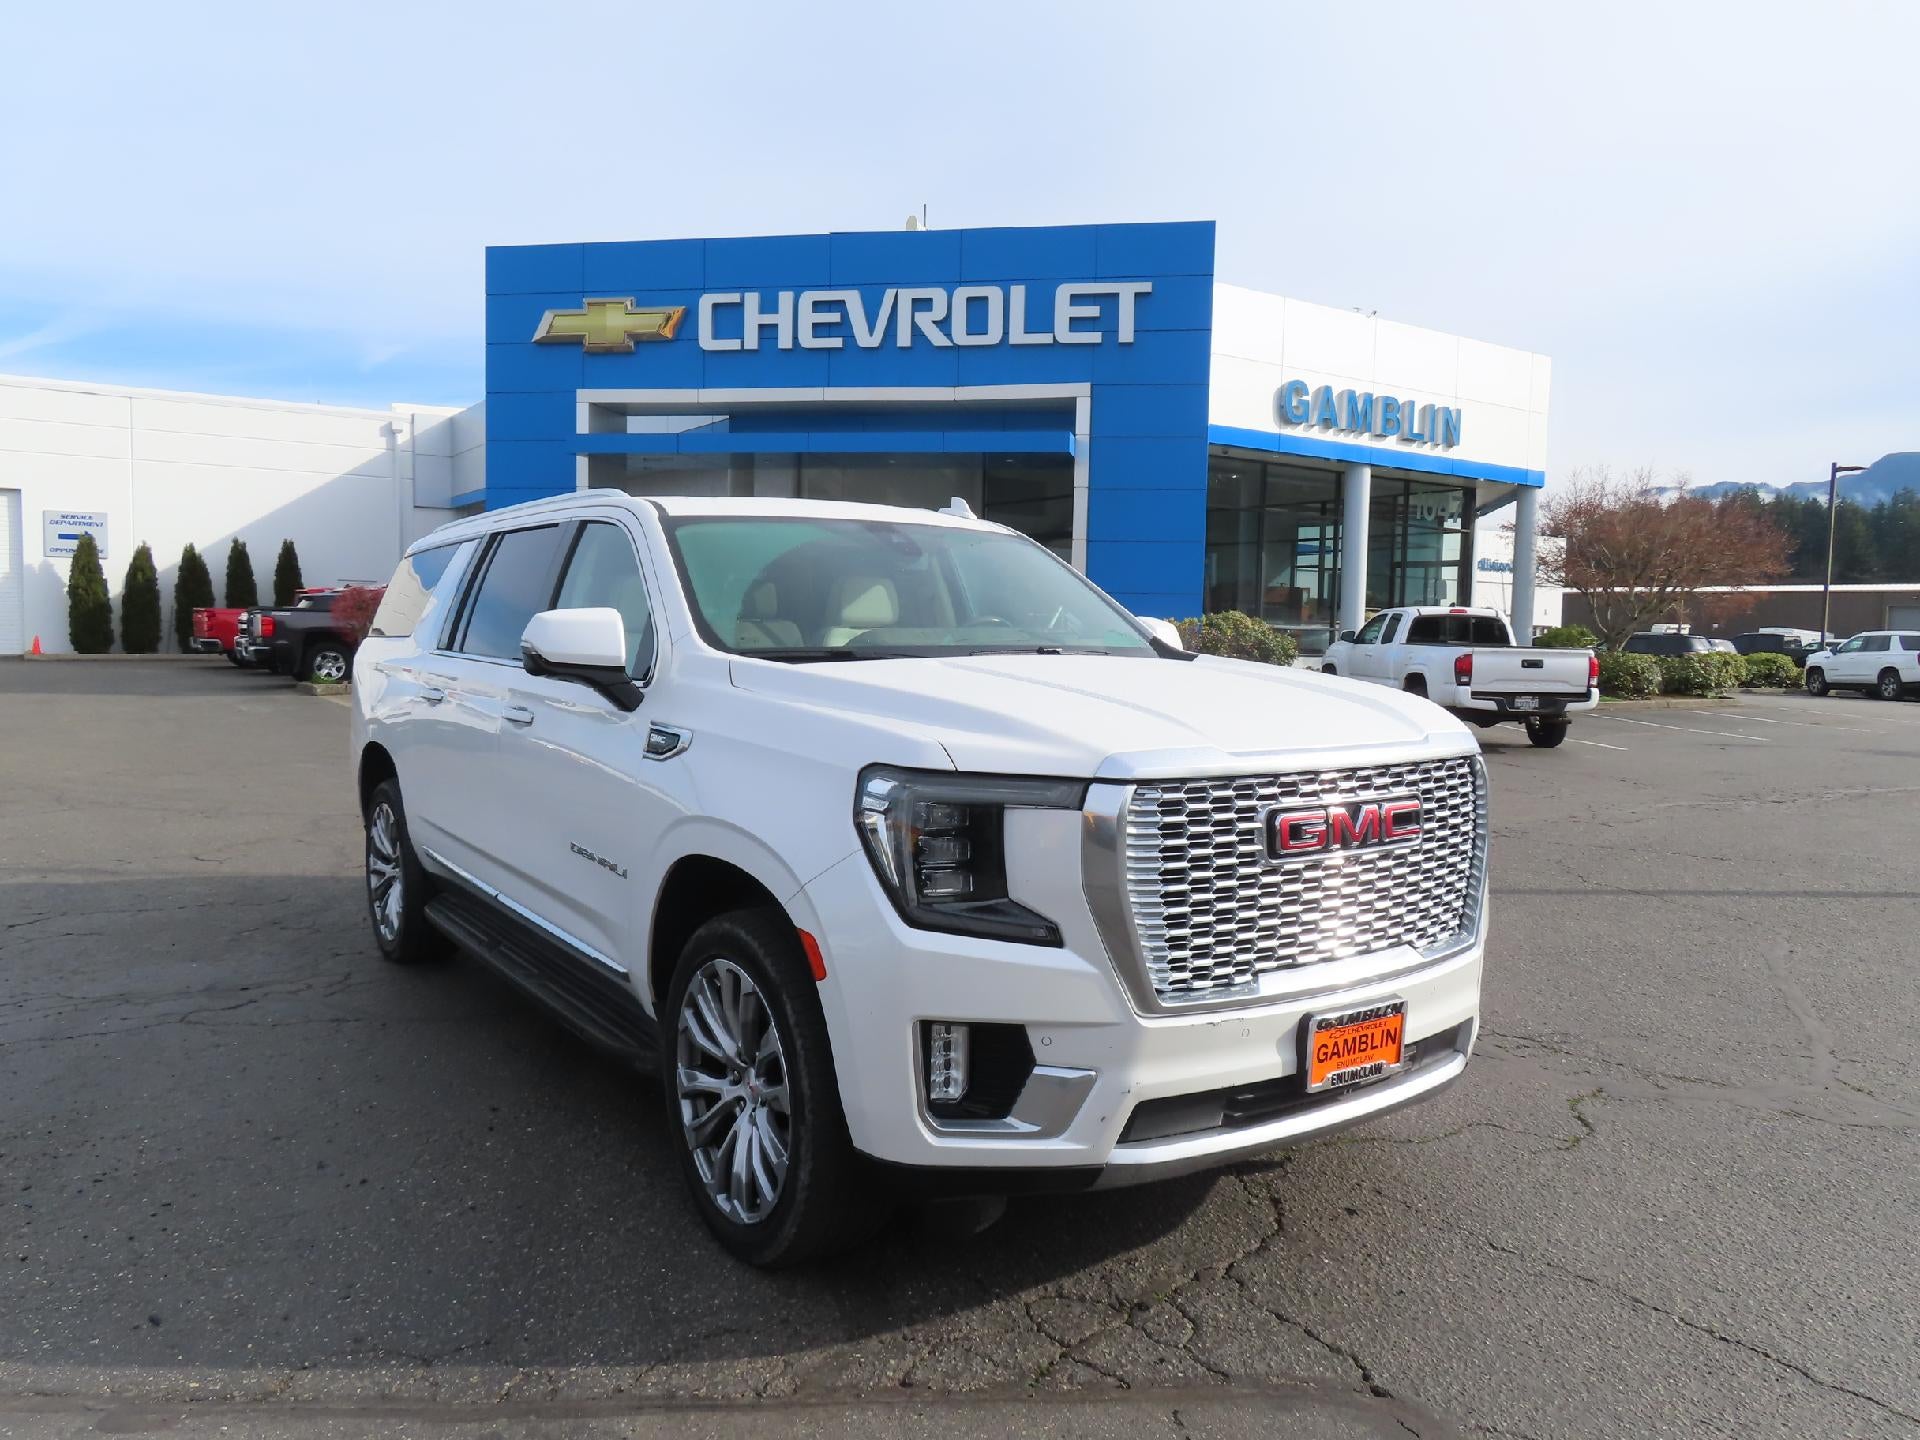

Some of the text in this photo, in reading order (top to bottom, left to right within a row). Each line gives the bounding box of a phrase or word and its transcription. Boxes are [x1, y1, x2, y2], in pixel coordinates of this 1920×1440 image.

[698, 281, 1152, 350] CHEVROLET
[1274, 379, 1462, 450] GAMBLIN
[49, 519, 104, 527] DEPARTMENT
[1275, 800, 1421, 854] GMC
[1347, 1020, 1388, 1036] CHEVROLET
[1316, 1027, 1398, 1064] GAMBLIN
[1336, 1053, 1375, 1069] ENUMCLAW
[1330, 1062, 1384, 1087] ENUMCLAW
